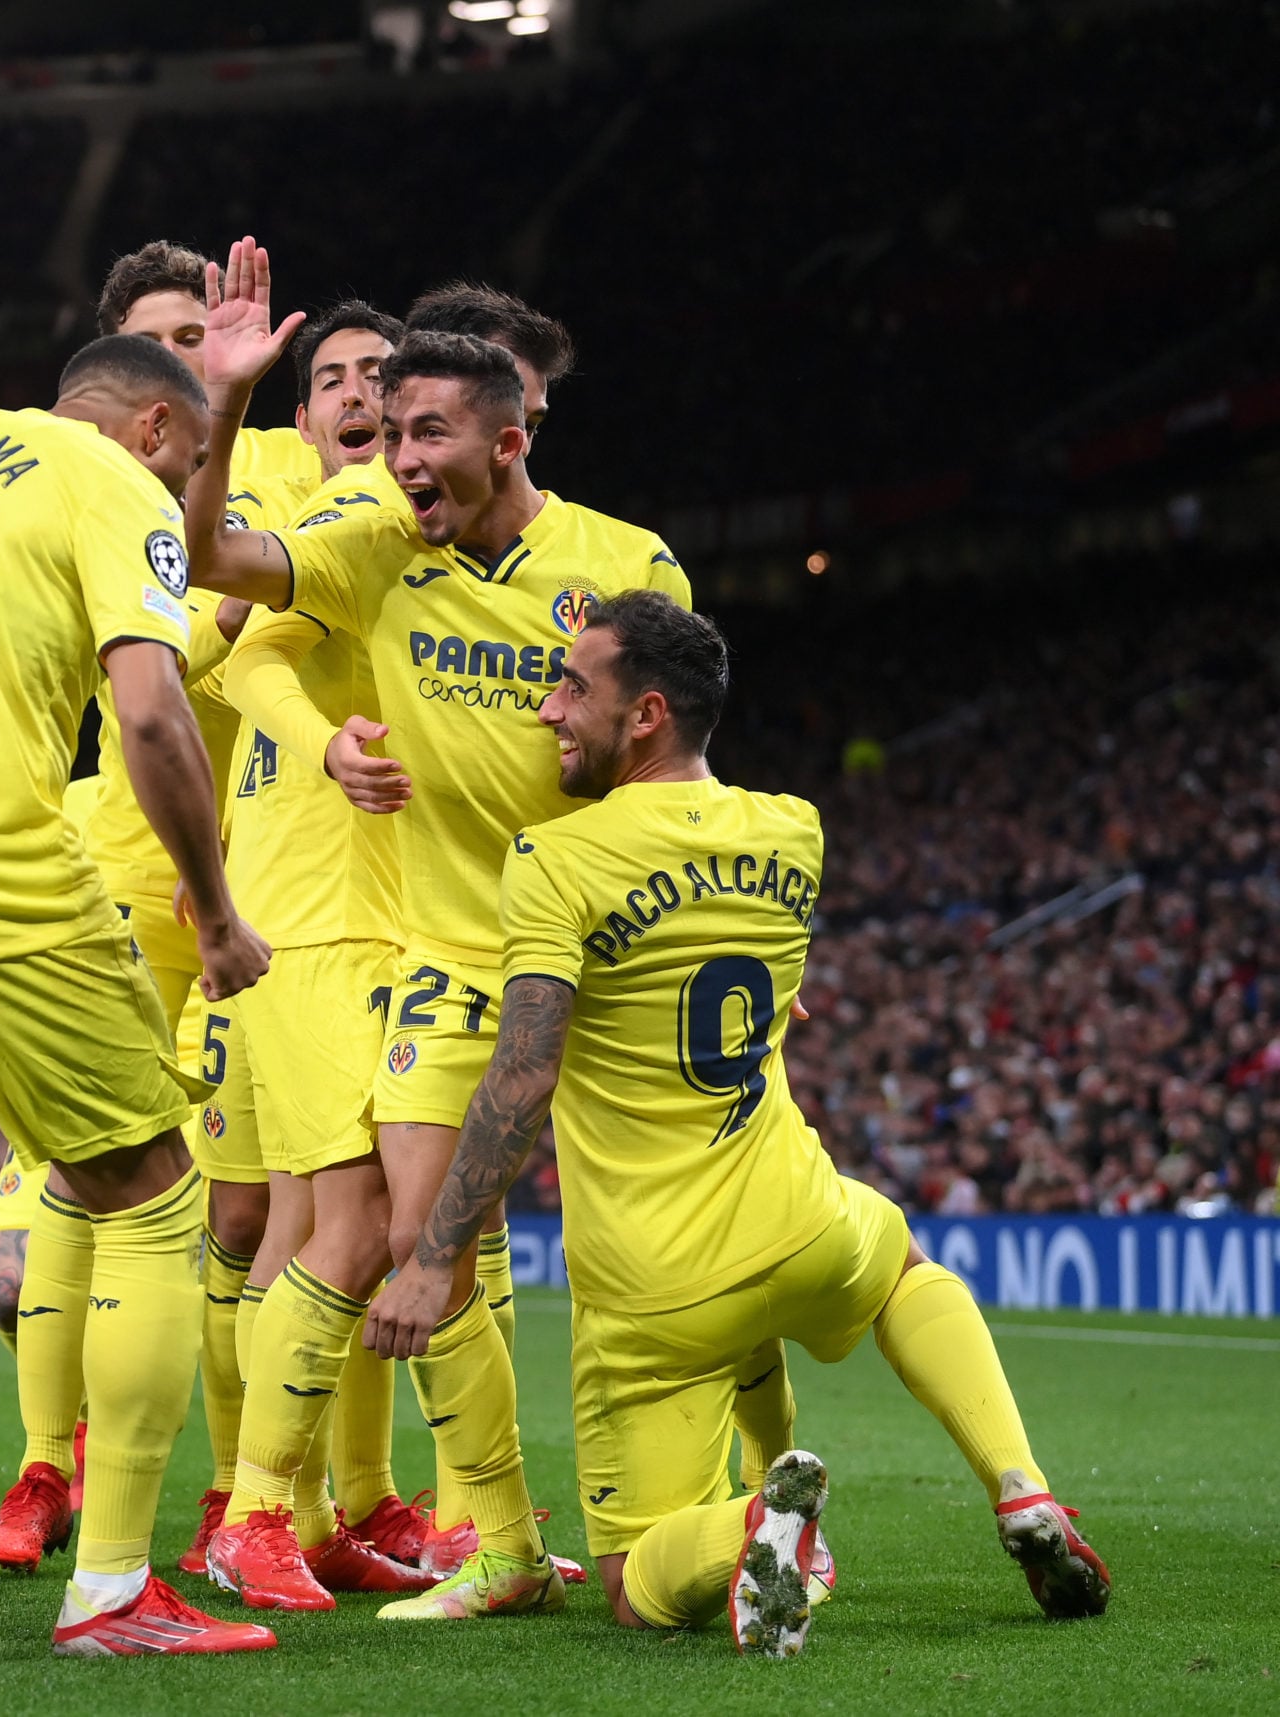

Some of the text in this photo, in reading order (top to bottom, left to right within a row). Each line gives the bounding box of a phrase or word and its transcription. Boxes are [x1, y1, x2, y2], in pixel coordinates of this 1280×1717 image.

[409, 630, 566, 684] PAMES
[418, 677, 553, 711] cerámi
[582, 870, 680, 967] PACO
[395, 965, 491, 1034] 21
[202, 1013, 231, 1085] 5
[677, 954, 776, 1149] 9
[997, 1223, 1100, 1310] NO
[1119, 1225, 1280, 1319] LIMI
